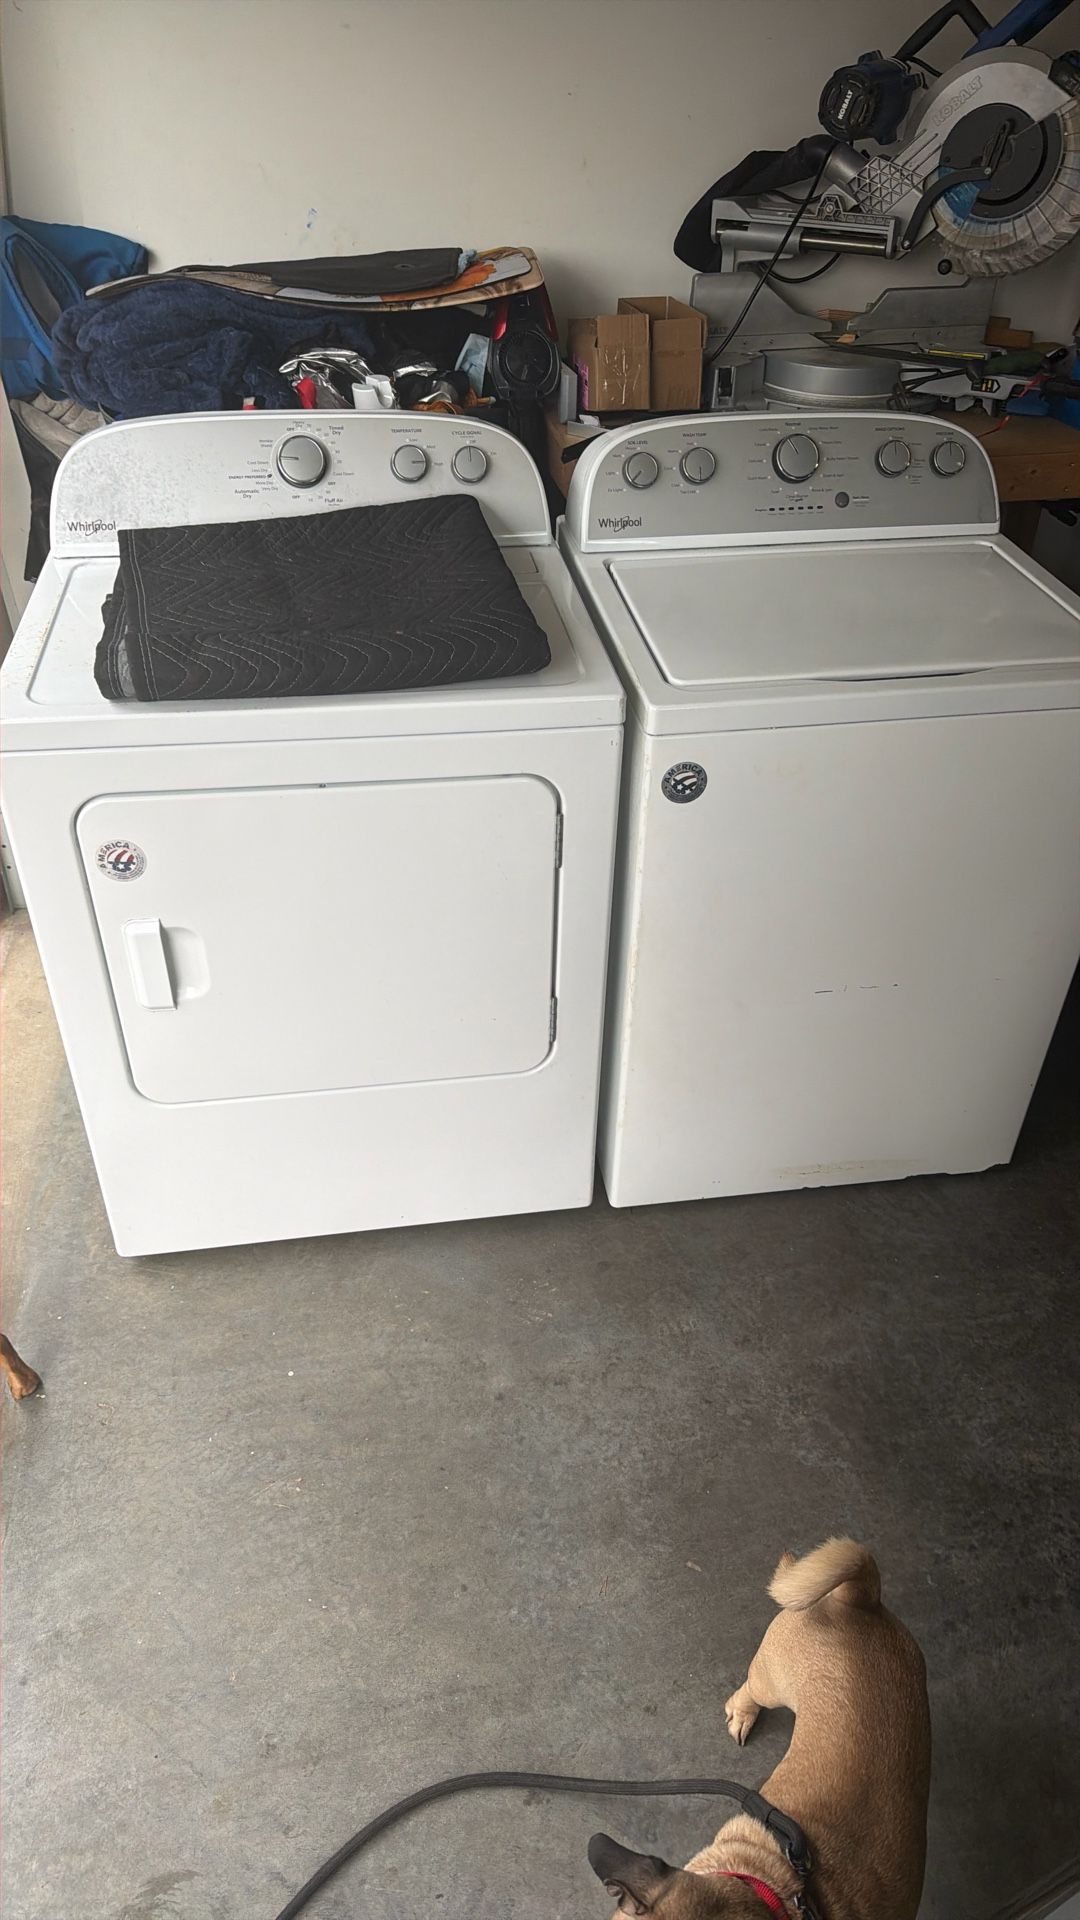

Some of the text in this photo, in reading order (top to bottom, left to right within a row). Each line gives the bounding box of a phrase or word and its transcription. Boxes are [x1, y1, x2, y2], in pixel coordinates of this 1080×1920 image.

[838, 90, 853, 119] KOBALT
[933, 75, 984, 127] KOBALT
[67, 520, 116, 536] Whirlpool
[598, 517, 642, 532] Whirlpool
[664, 764, 702, 784] AMERICA
[98, 841, 130, 868] AMERICA
